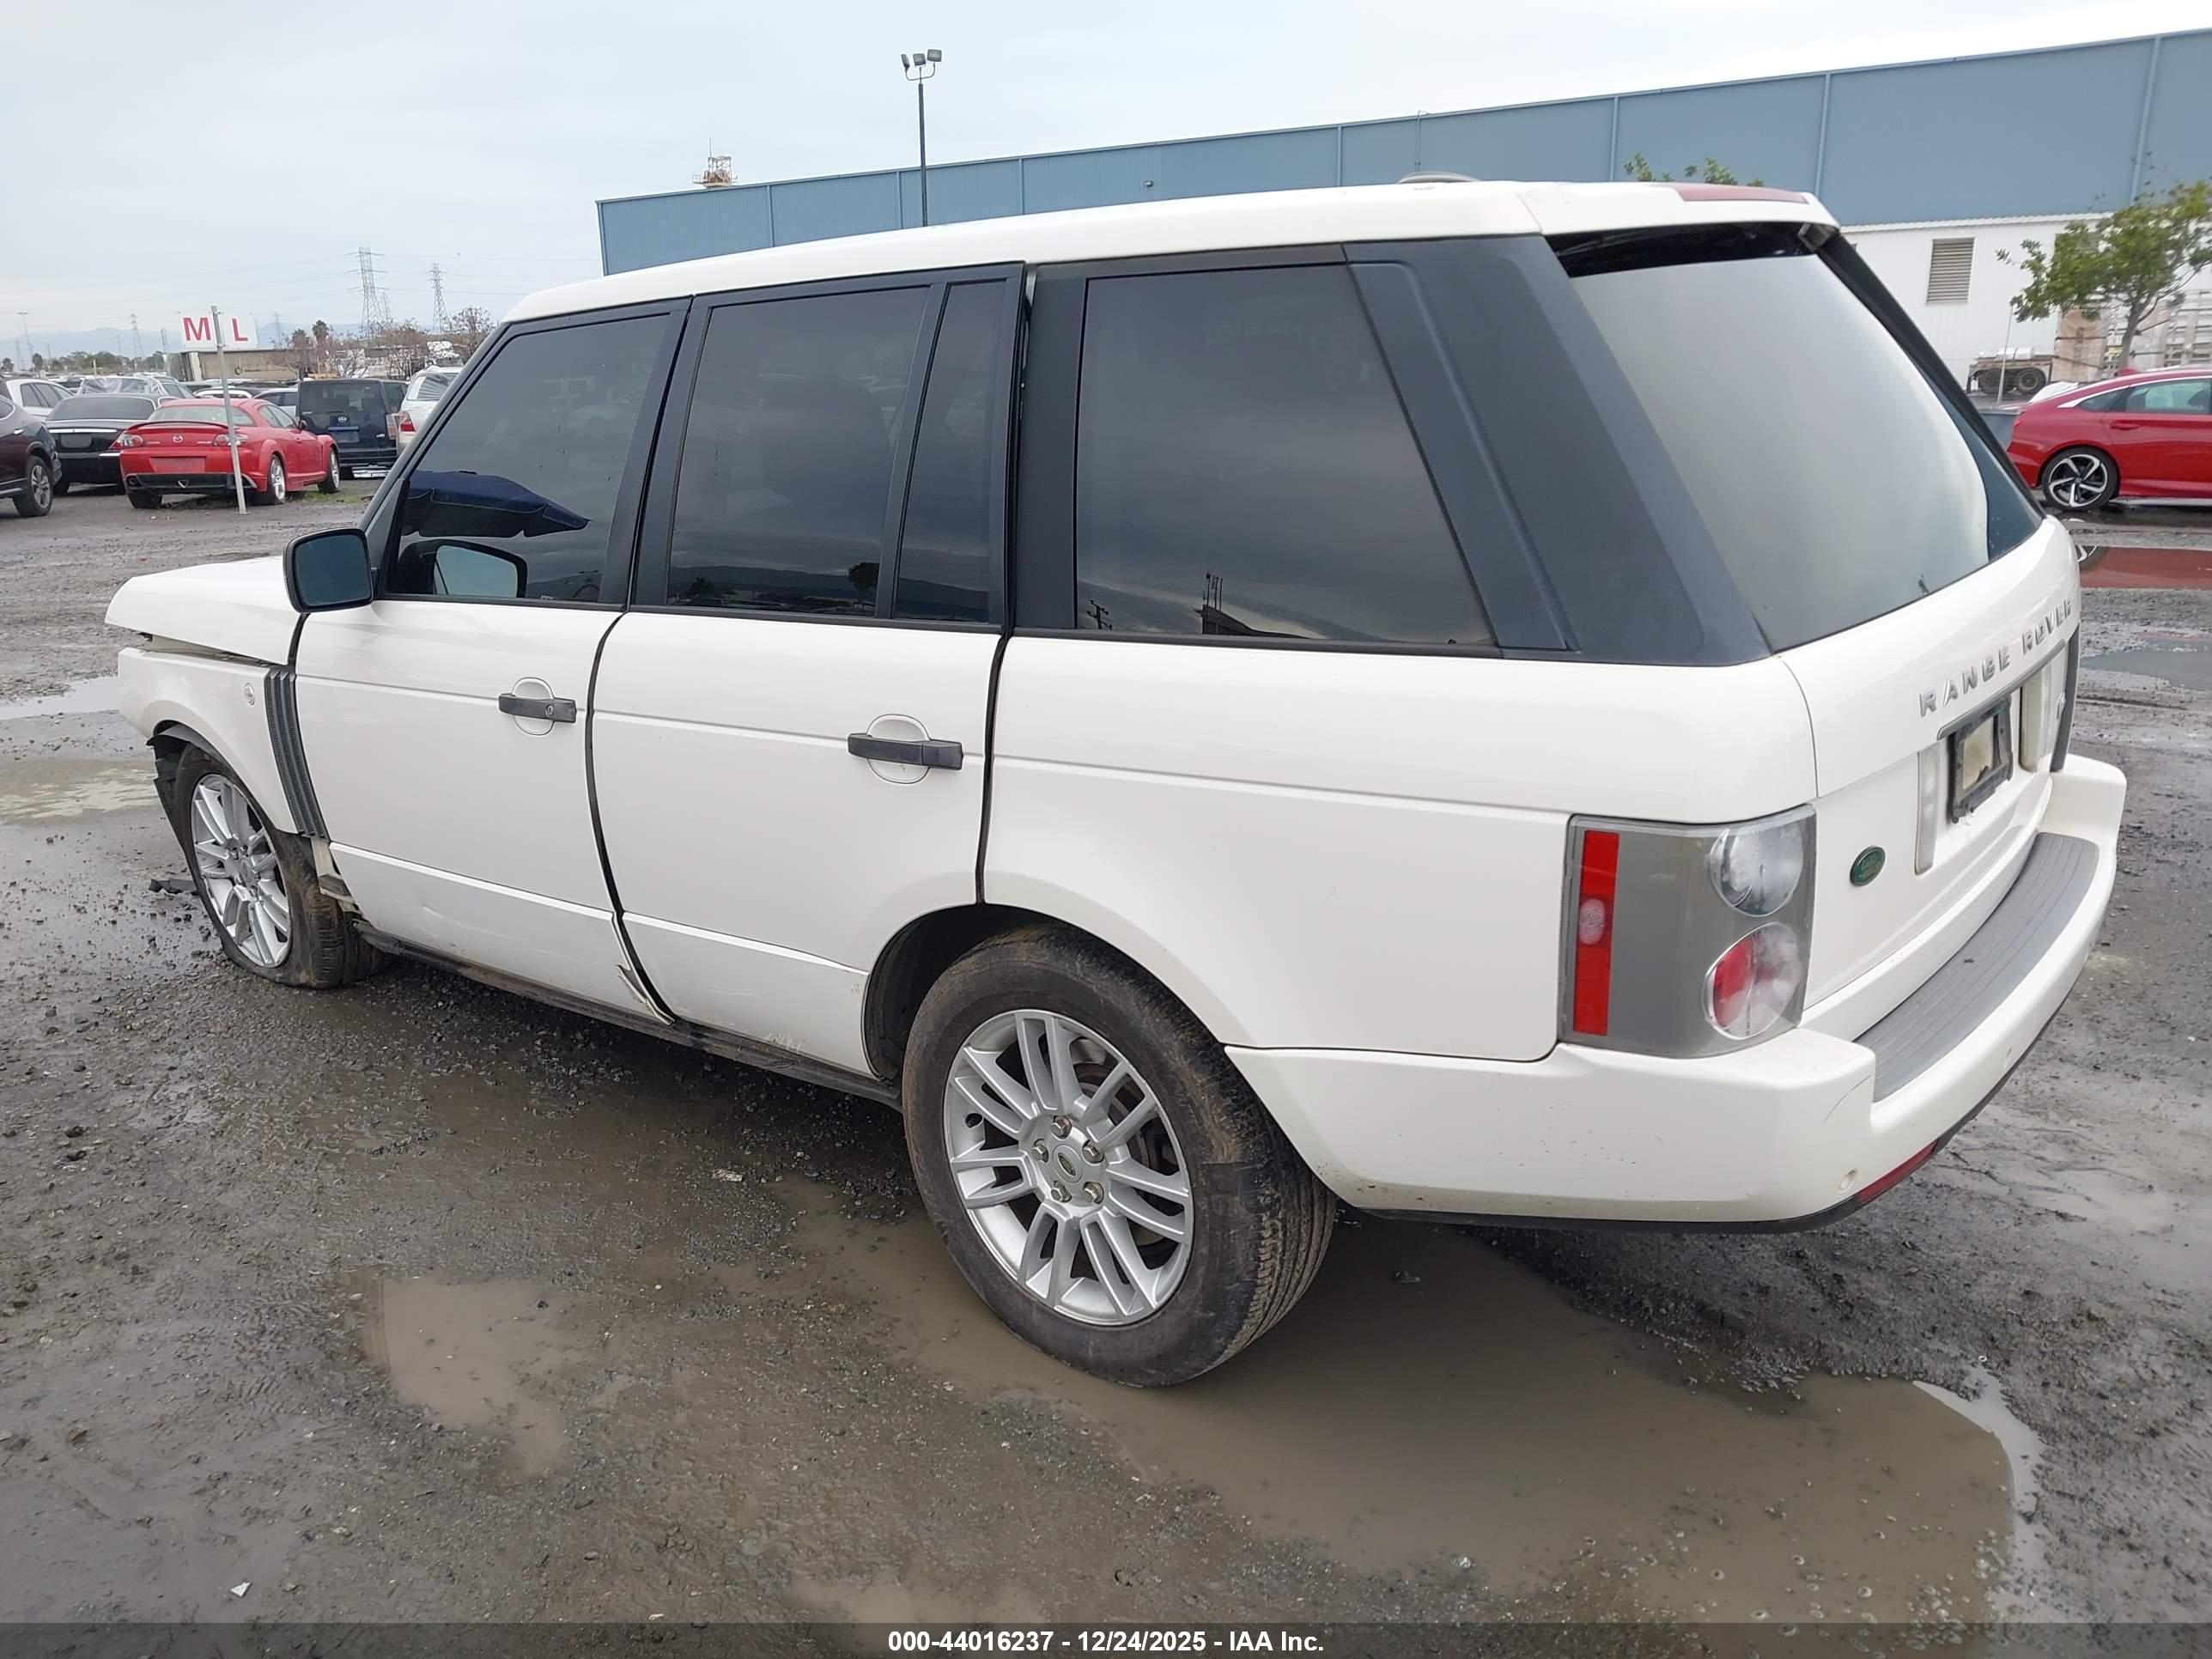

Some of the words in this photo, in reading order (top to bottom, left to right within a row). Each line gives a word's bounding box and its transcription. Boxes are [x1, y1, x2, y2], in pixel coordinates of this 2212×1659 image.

[183, 317, 211, 342] M
[232, 318, 248, 342] L
[1918, 646, 2011, 718] RANGE
